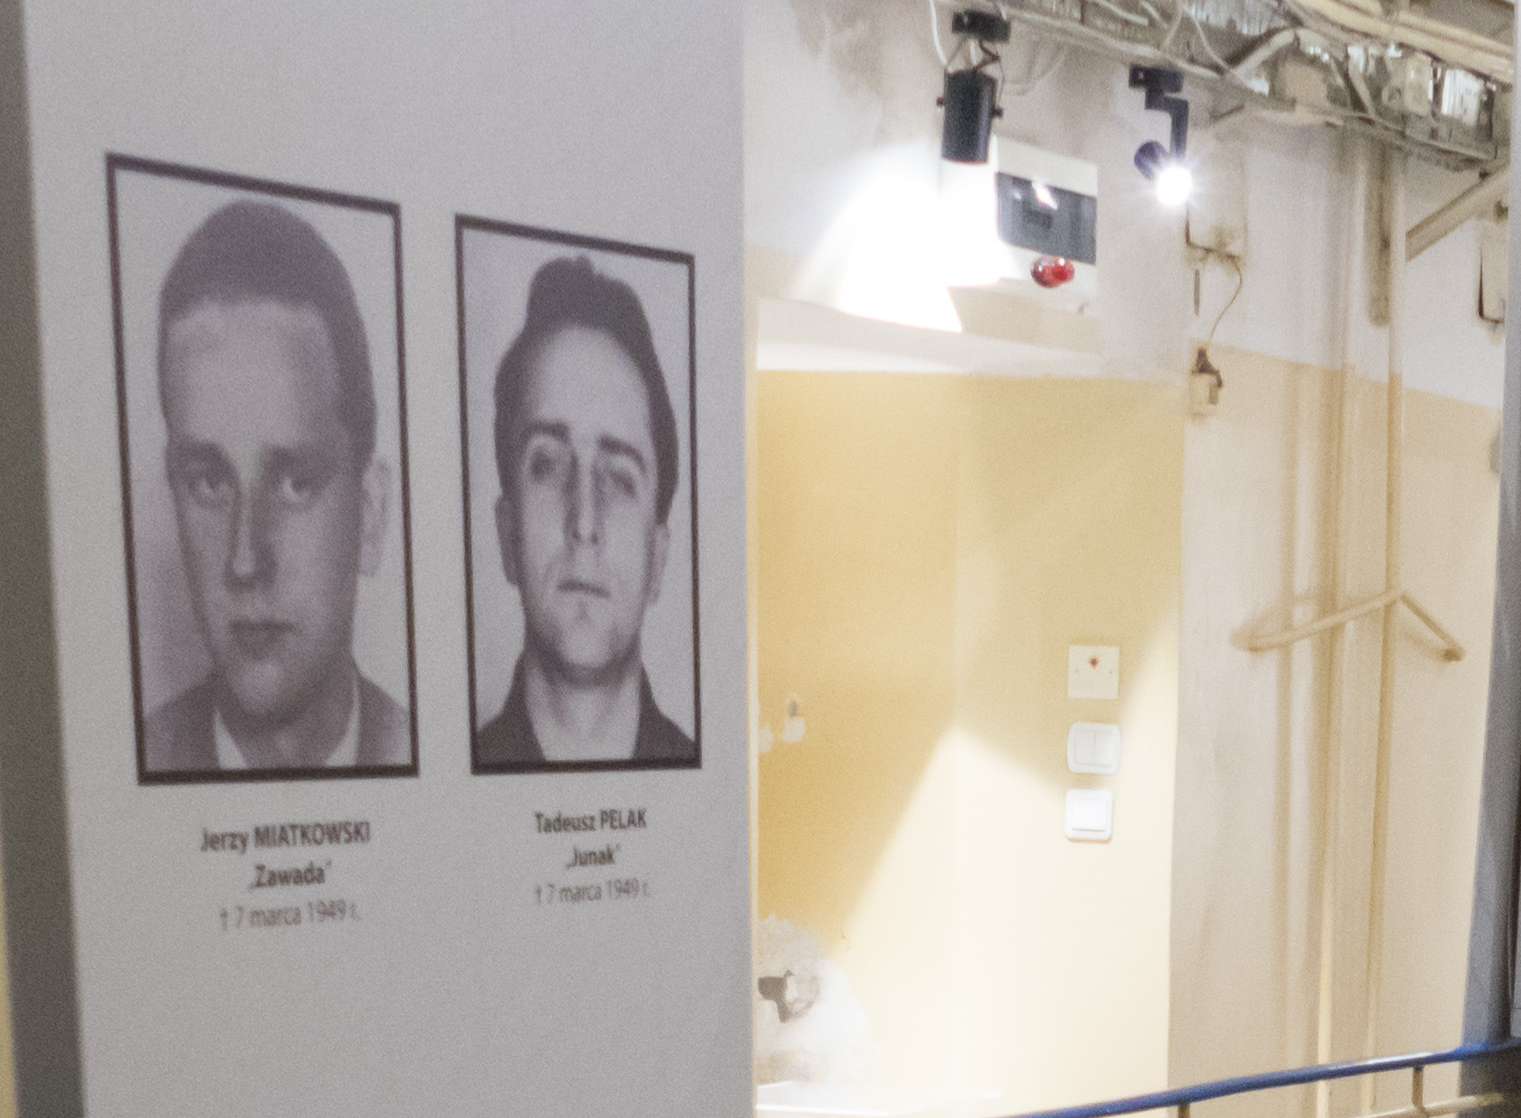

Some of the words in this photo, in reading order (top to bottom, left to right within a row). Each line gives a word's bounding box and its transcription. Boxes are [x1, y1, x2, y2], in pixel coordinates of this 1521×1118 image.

[534, 810, 596, 834] Tadeusz
[600, 807, 648, 832] PELAK
[200, 825, 249, 855] Jerzy
[253, 820, 371, 848] MIATKOWSKI
[558, 884, 602, 903] marca
[605, 878, 639, 900] 1949
[249, 906, 303, 928] marca
[306, 898, 348, 923] 1949
